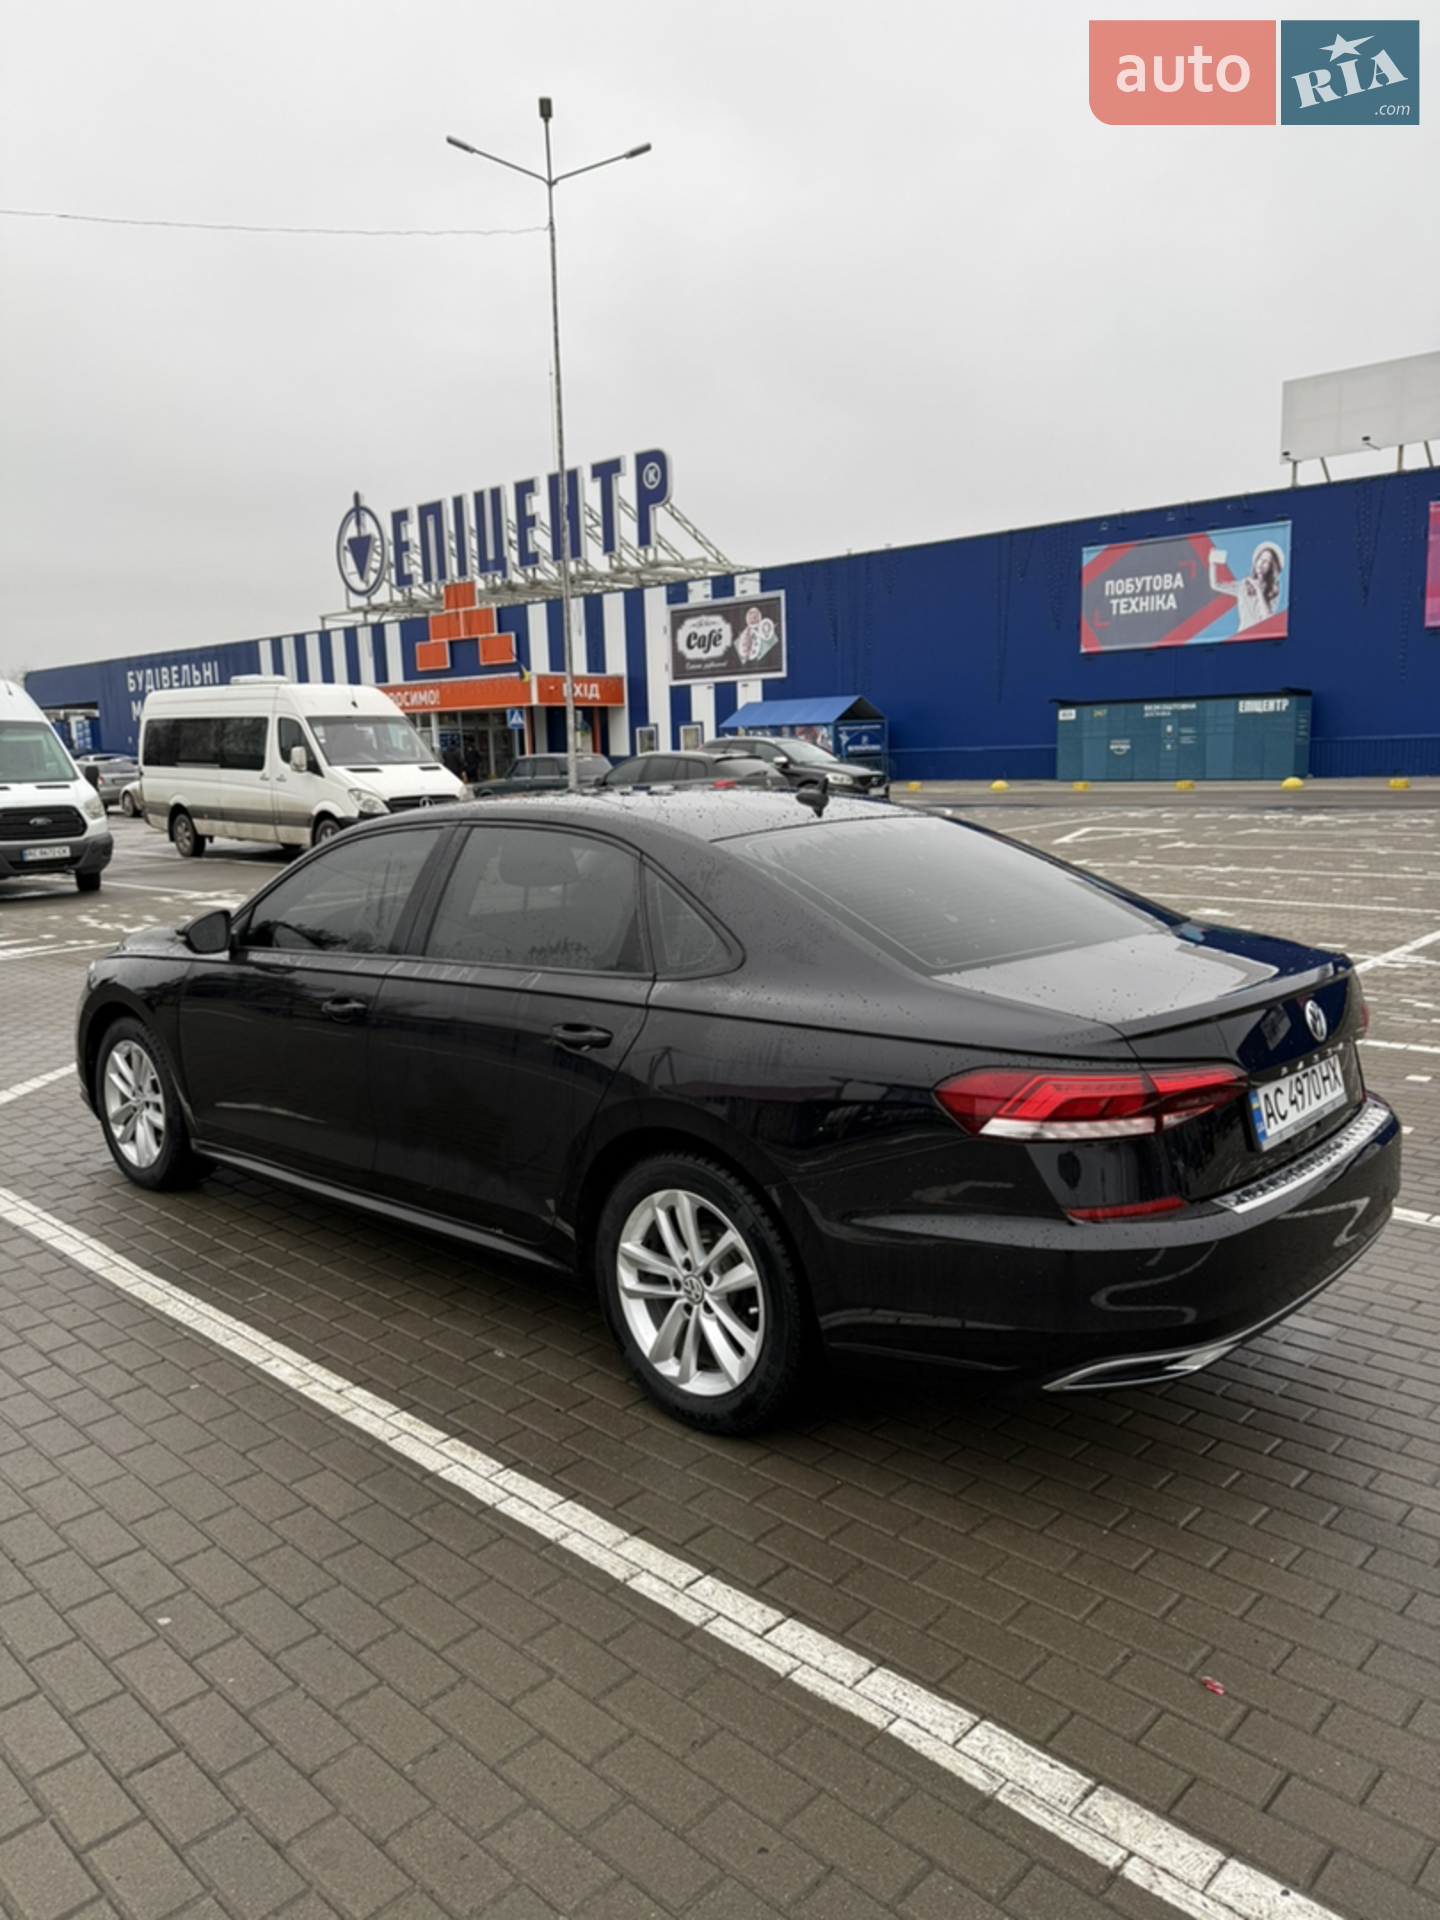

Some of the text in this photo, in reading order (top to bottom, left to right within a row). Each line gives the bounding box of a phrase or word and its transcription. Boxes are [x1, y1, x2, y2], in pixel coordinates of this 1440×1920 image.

[390, 449, 672, 589] ЕПІЦЕНТР
[1105, 571, 1185, 597] ПОБУТОВА
[1110, 592, 1178, 616] ТЕХНІКА
[685, 628, 723, 655] Café
[127, 660, 220, 694] БУДІВЕЛЬНІ
[1238, 698, 1289, 714] ЕПІЦЕНТР
[1263, 1085, 1288, 1129] AC
[1288, 1068, 1322, 1113] 4970
[1319, 1054, 1343, 1096] HX
